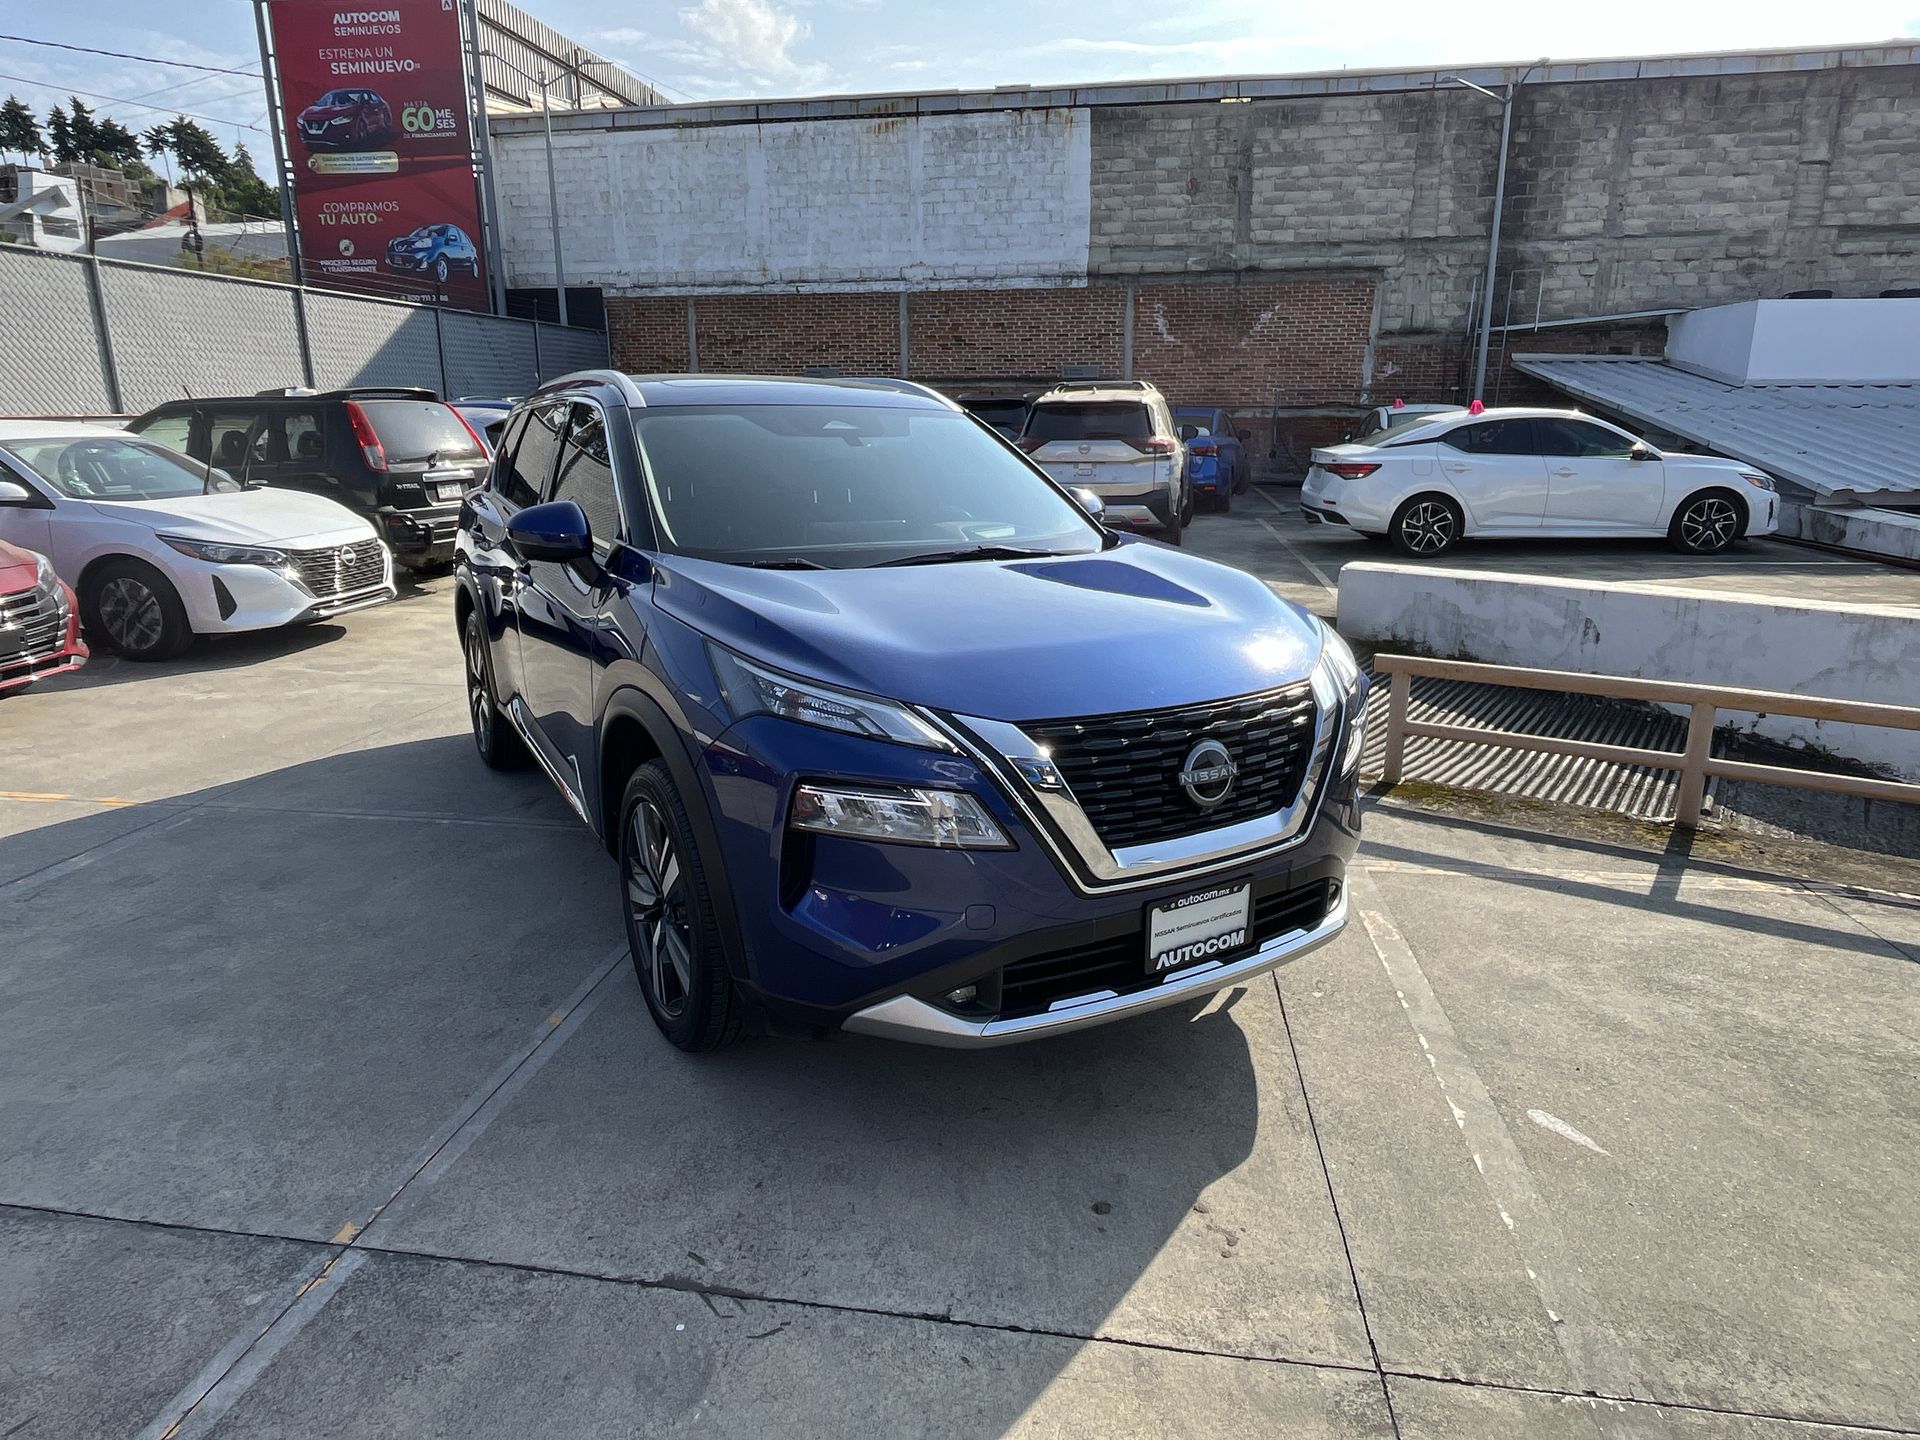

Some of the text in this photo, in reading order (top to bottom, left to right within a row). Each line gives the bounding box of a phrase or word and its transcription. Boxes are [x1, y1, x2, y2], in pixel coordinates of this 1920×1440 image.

[333, 11, 400, 25] AUTOCOM
[334, 25, 401, 37] SEMINUEVOS
[319, 47, 393, 60] ESTRENA UN
[331, 60, 414, 75] SEMINUEVO
[402, 107, 435, 132] 60
[436, 119, 456, 128] SES
[323, 201, 399, 213] COMPRAMOS
[318, 213, 377, 225] TU AUTO
[1181, 762, 1237, 784] NISSAN
[1177, 888, 1230, 907] autocom.mx
[1154, 909, 1242, 938] NISSAN Seminuevos Certificados
[1156, 929, 1245, 970] AUTOCOM
